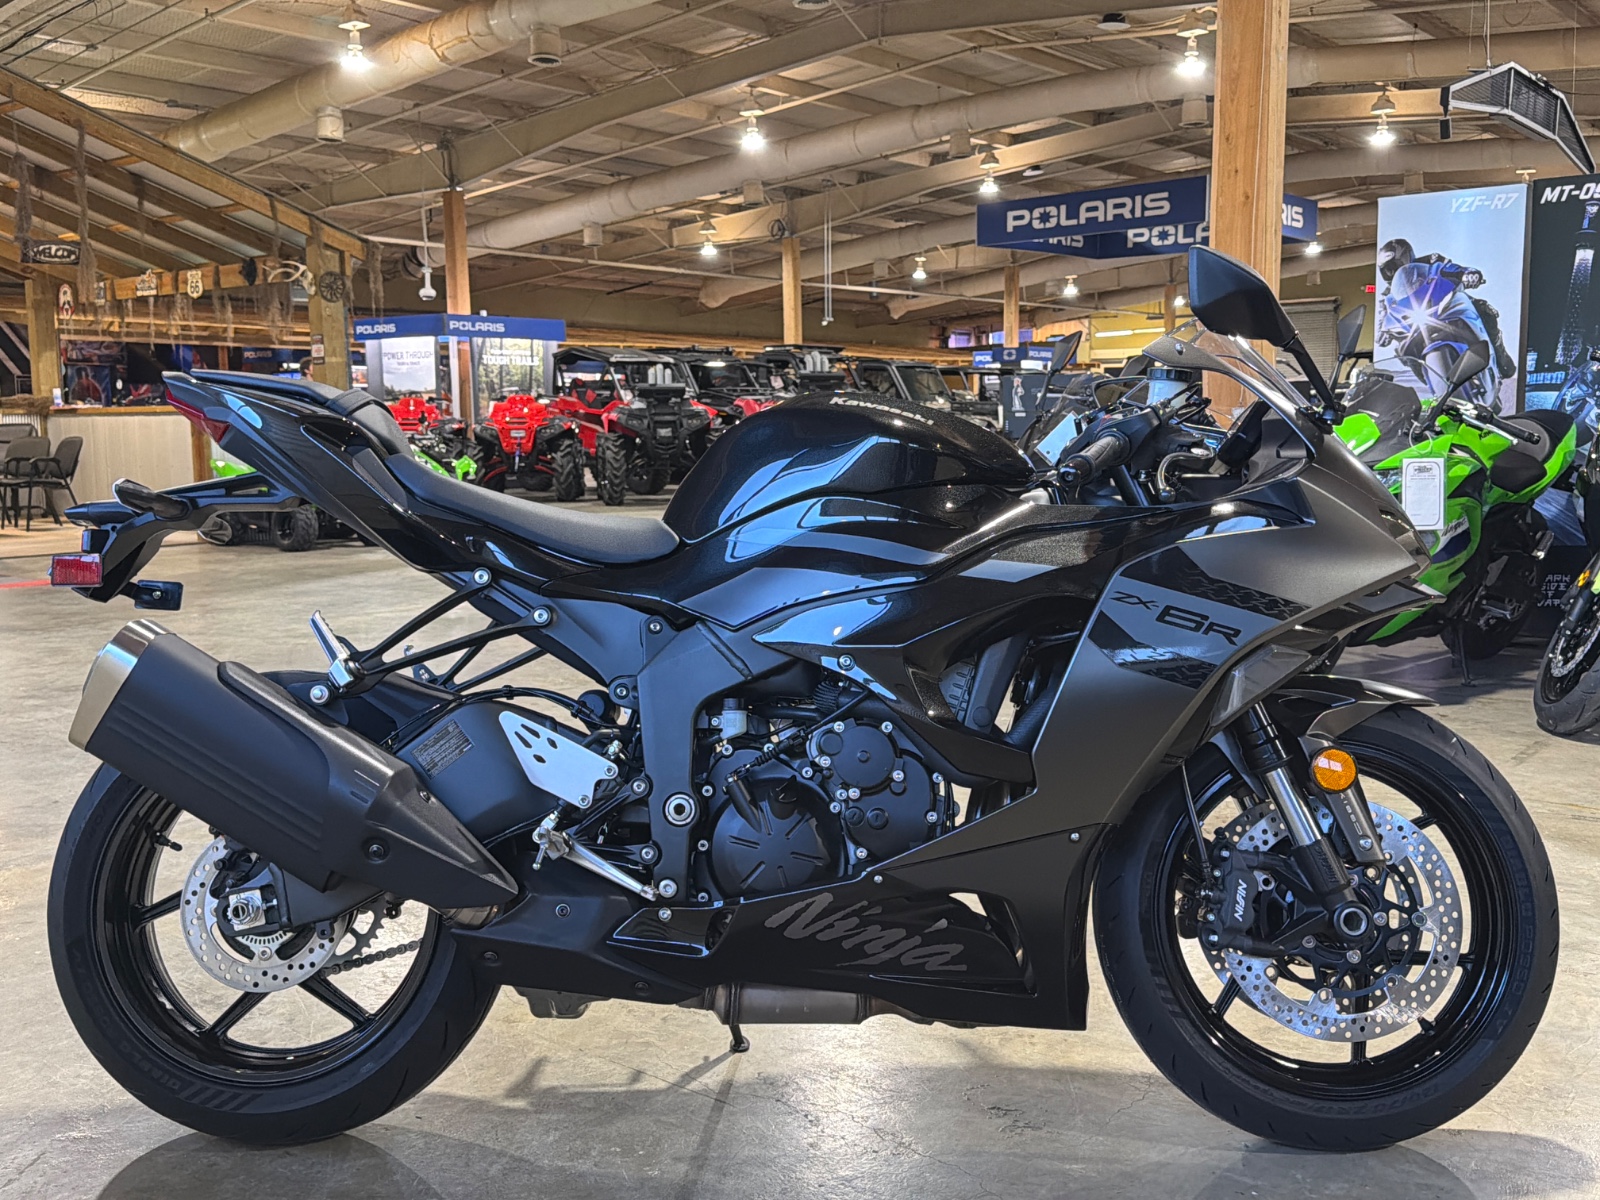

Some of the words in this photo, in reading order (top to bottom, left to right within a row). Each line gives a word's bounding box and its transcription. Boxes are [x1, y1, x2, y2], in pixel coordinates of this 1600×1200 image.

[1006, 191, 1171, 232] POLARIS
[1451, 193, 1520, 213] YZF-R7
[190, 280, 200, 294] 66
[355, 323, 396, 335] POLARIS
[449, 320, 505, 332] POLARIS
[482, 355, 509, 365] TOUGH
[511, 355, 539, 366] TRAILS
[829, 397, 934, 425] Kawasaki
[1109, 591, 1242, 646] ZX-6R
[764, 892, 967, 971] Ninja
